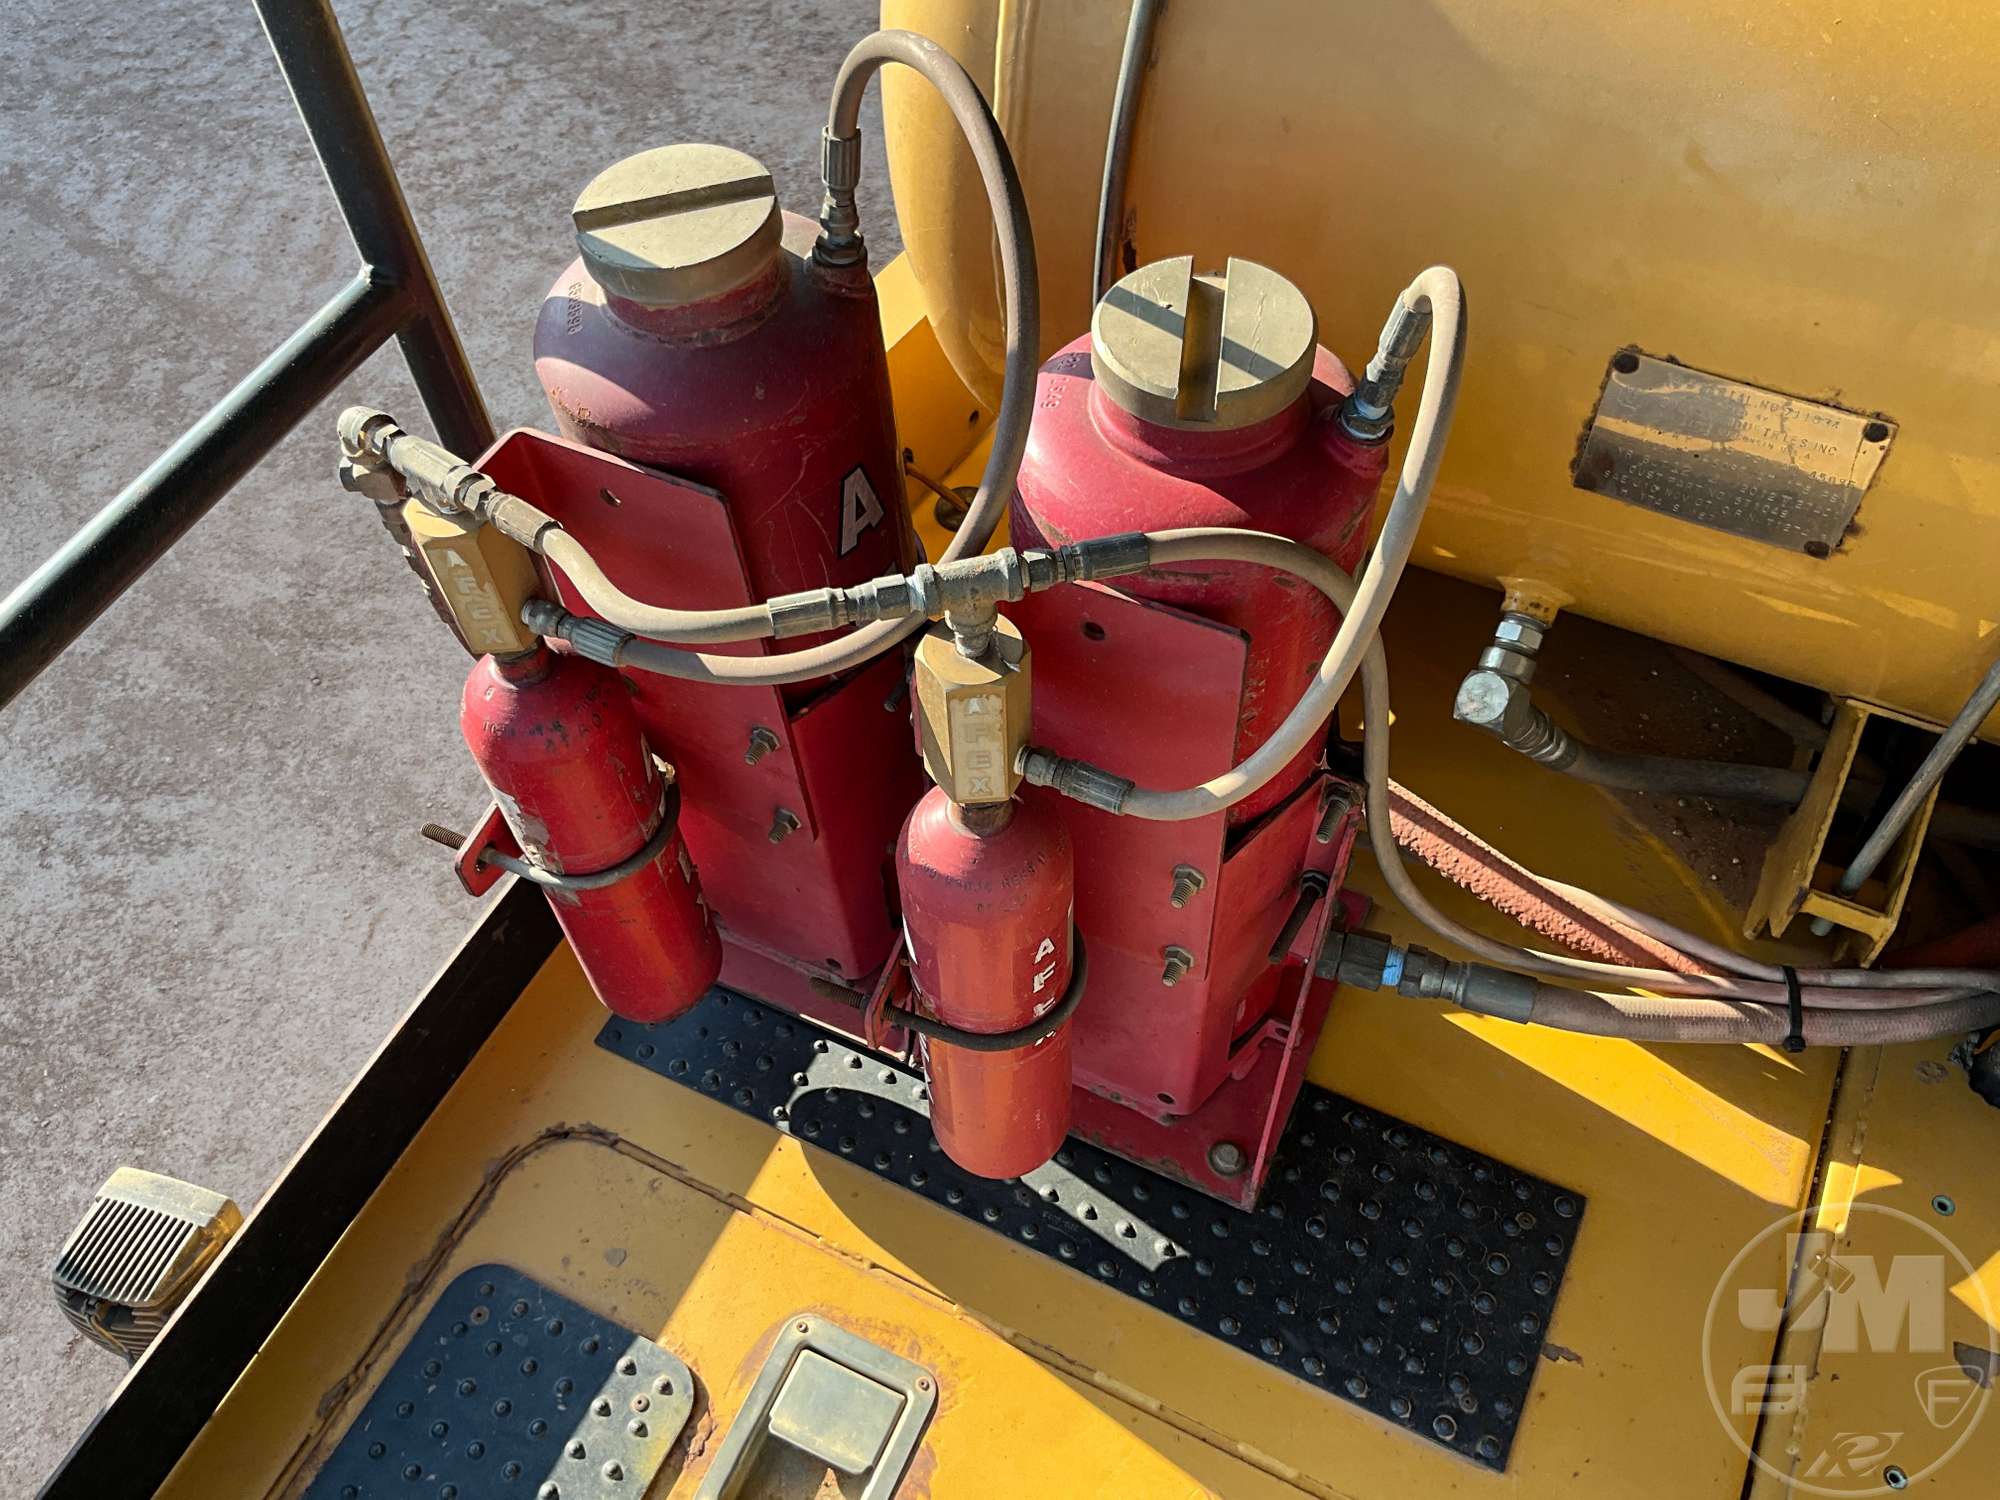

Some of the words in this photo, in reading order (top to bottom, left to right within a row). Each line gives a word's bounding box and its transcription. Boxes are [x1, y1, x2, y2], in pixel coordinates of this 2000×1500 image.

[446, 549, 506, 646] AFEX
[963, 696, 995, 796] AFEX
[1033, 937, 1057, 1047] AFE
